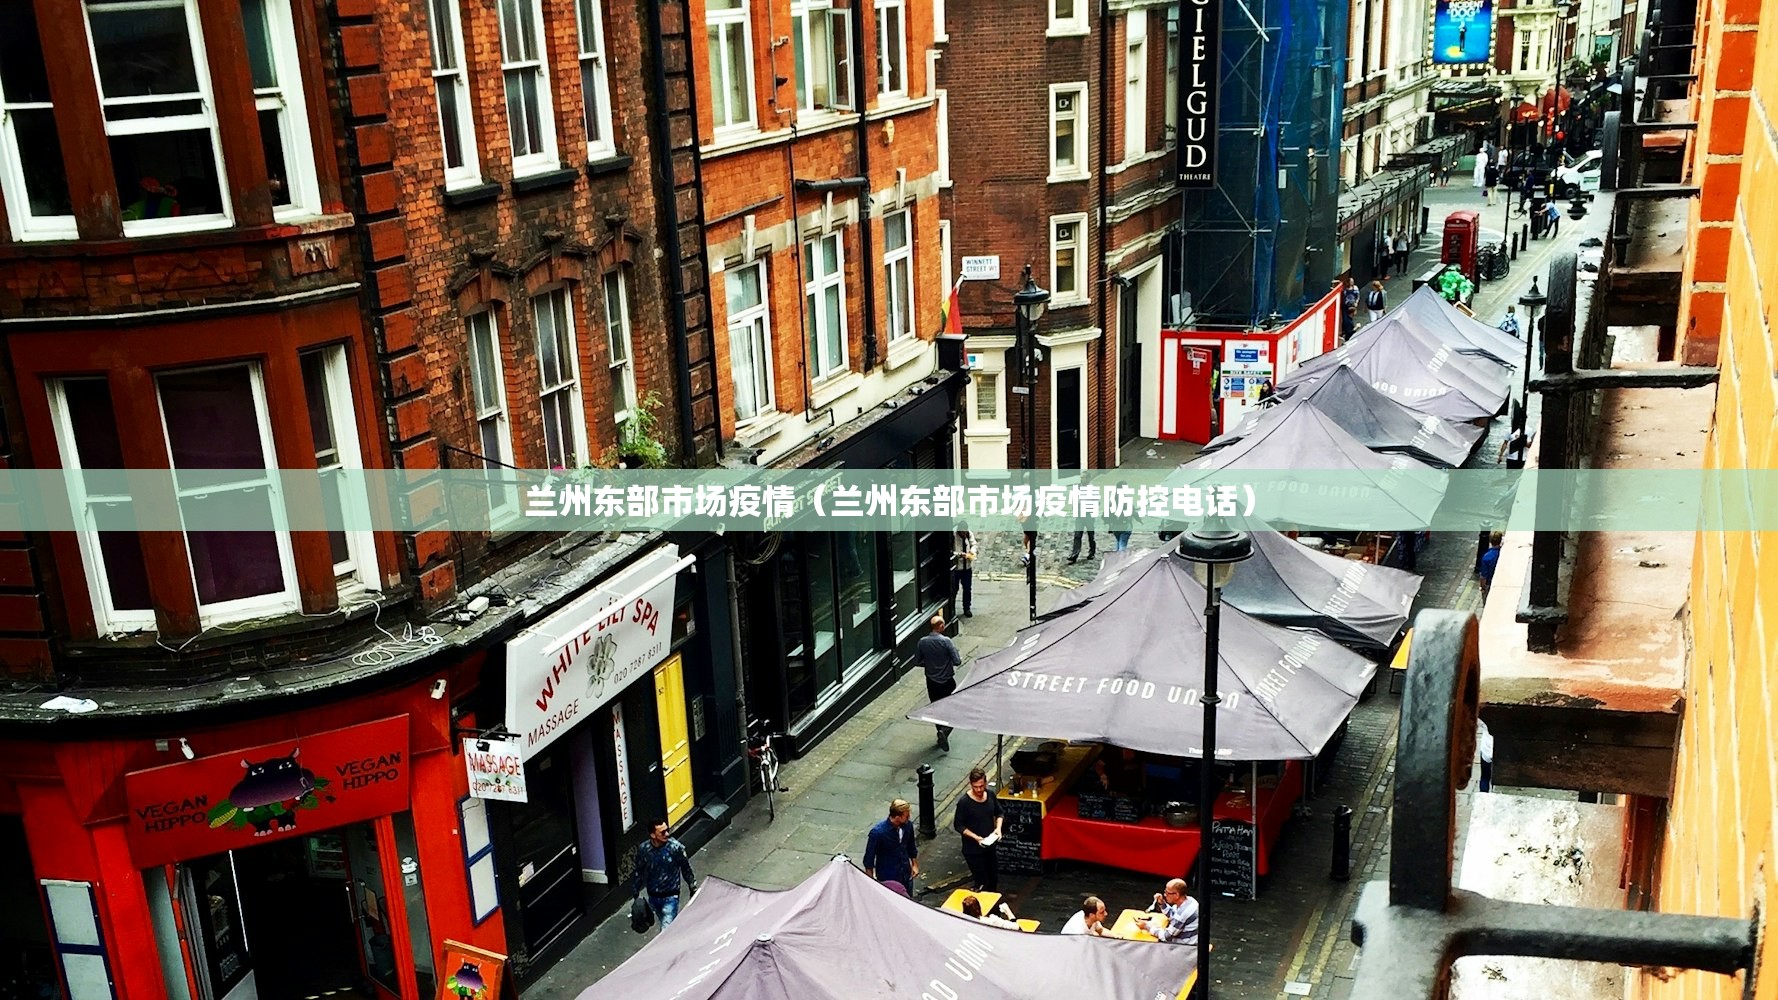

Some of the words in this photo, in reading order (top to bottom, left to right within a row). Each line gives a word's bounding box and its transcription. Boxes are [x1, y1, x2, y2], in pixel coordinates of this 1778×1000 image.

[1450, 8, 1476, 18] DOG
[1185, 0, 1208, 168] IELGUD
[1179, 173, 1211, 181] THEATRE
[966, 265, 987, 273] STREET
[1372, 381, 1398, 395] OOD
[1267, 480, 1309, 494] FOOD
[1318, 484, 1371, 499] UNION
[535, 629, 592, 713] WHITE
[632, 598, 659, 637] SPA
[613, 668, 628, 684] 020
[629, 653, 646, 674] 7287
[1007, 670, 1088, 694] STREET
[1096, 677, 1156, 700] FOOD
[528, 698, 579, 748] MASSAGE
[335, 751, 402, 777] VEGAN
[468, 752, 522, 776] MASSAGE
[612, 710, 628, 821] MASSAGE
[343, 768, 399, 791] HIPPO
[135, 794, 208, 820] VEGAN
[144, 811, 206, 833] HIPPO
[944, 933, 995, 982] UNION
